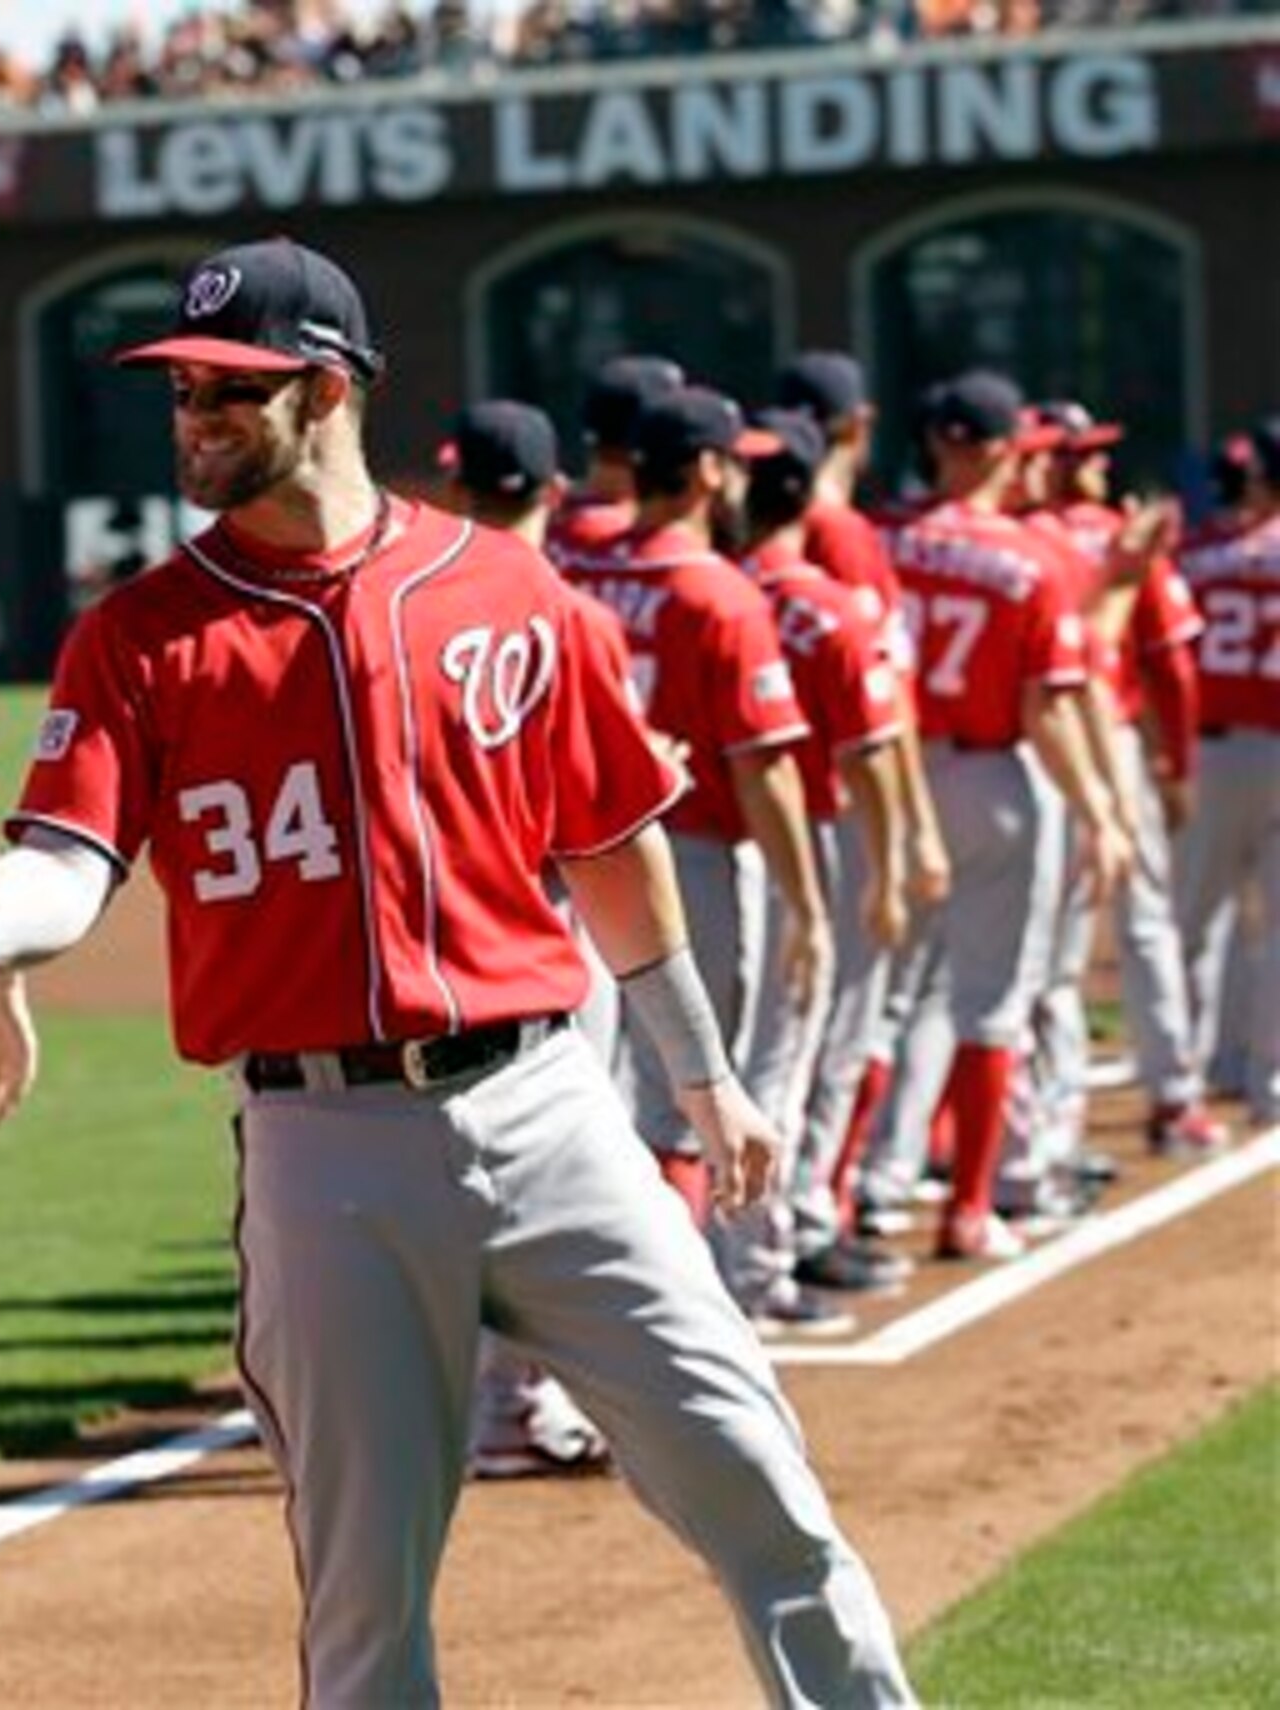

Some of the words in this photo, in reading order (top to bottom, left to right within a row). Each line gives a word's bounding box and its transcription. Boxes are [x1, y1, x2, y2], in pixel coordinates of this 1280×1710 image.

[489, 54, 1161, 190] LANDING
[441, 613, 557, 751] W
[179, 760, 342, 904] 34
